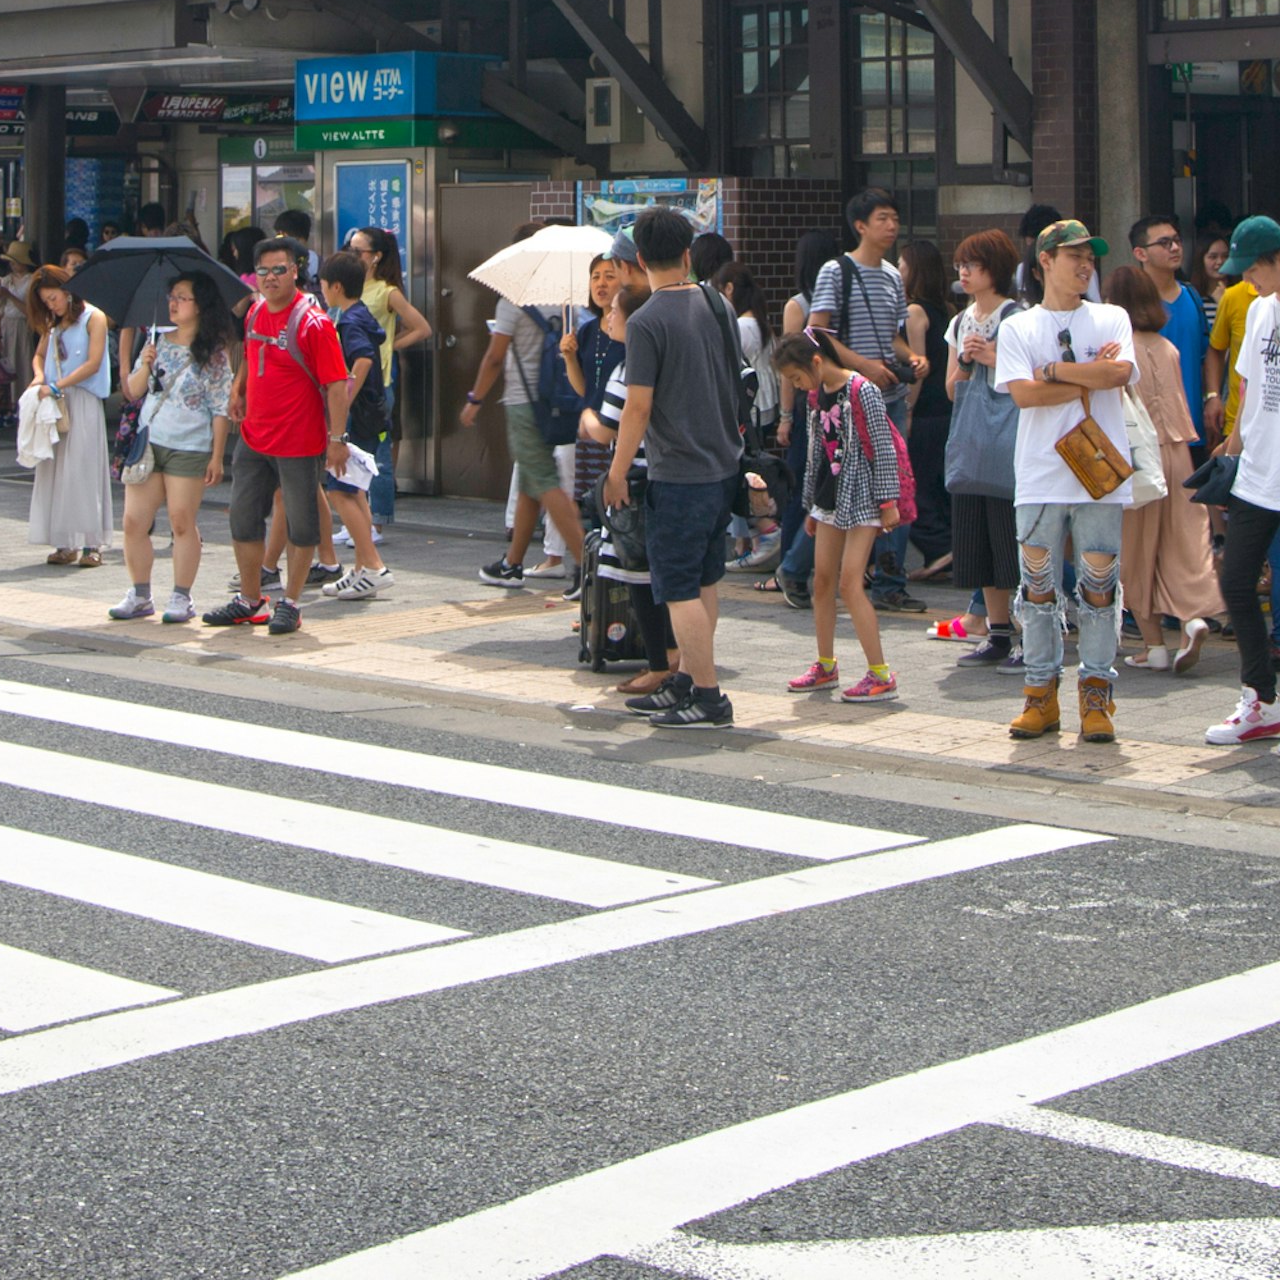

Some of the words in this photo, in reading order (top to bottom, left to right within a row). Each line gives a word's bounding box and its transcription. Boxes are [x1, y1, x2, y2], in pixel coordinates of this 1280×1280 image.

[373, 68, 402, 86] ATM
[373, 85, 405, 101] コーナー
[322, 132, 350, 142] VIEW
[351, 130, 385, 141] ALTTE
